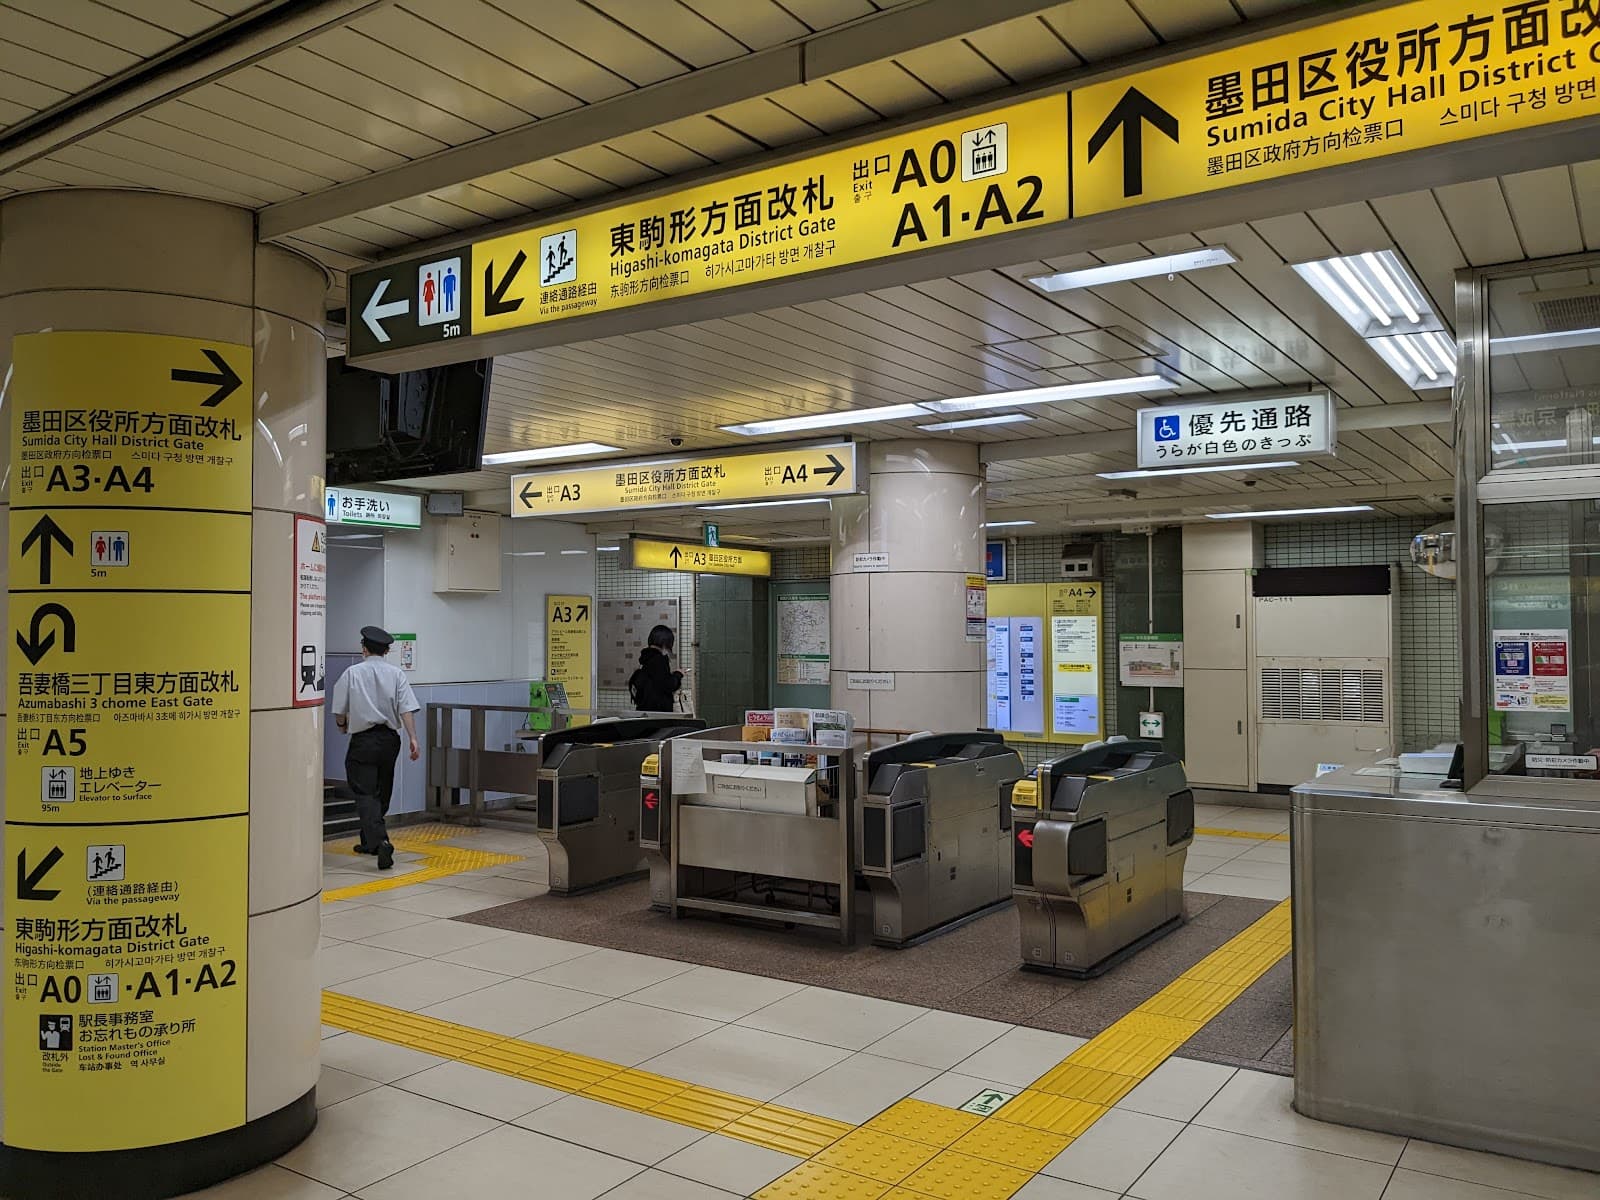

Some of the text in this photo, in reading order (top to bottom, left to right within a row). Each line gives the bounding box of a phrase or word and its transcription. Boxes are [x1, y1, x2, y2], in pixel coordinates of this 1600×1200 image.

[1207, 106, 1308, 147] Sumida
[1319, 95, 1376, 121] City
[1388, 74, 1445, 107] Hall
[1459, 48, 1576, 91] District
[1440, 77, 1597, 126] 스미다 구청 방면
[1207, 118, 1403, 176] 墨田区政府方向检票口
[853, 140, 956, 194] 出口 A0
[854, 180, 872, 192] Exit
[610, 174, 834, 257] 東駒形方面改札
[610, 216, 836, 277] Higashi-komagata District Gate
[705, 240, 836, 280] 히가시고마가타 방면 개찰구
[610, 270, 689, 298] 东驹形方向检票口
[540, 282, 596, 305] 連絡通路経由
[540, 298, 597, 315] Via the passageway
[443, 324, 460, 338] 5m
[22, 410, 242, 441] 墨田区役所方面改札
[1188, 404, 1312, 436] 優先通路
[22, 434, 204, 450] Sumida City Hall District Gate
[1156, 434, 1312, 459] うらが白色のきっぷ
[21, 450, 112, 460] 墨田区政府方向检票口
[131, 451, 234, 466] 스미다 구청 방면 개찰구
[21, 466, 44, 478] 出口
[616, 464, 726, 486] 墨田区役所方面改札
[764, 464, 808, 484] 出口 A4
[546, 484, 580, 502] 出口 A3
[624, 480, 716, 494] Sumida City Hall District Gate
[342, 496, 390, 512] お手洗い
[342, 510, 362, 518] Toilets
[694, 553, 706, 565] A3
[90, 568, 107, 578] 5m
[1068, 588, 1082, 598] A4
[552, 606, 572, 622] A3
[18, 670, 239, 696] 吾妻橋三丁目東方面改札
[18, 696, 213, 708] Azumabashi 3 chome East Gate
[114, 712, 154, 722] 아즈마바시
[156, 711, 177, 721] 3초메
[178, 710, 202, 720] 히가시
[203, 710, 218, 720] 방면
[18, 728, 86, 756] 出口 A5
[80, 766, 136, 780] 地上ゆき
[80, 780, 162, 794] エレベーター
[42, 804, 60, 812] 95m
[86, 894, 180, 906] Via the passageway
[16, 912, 187, 942] 東駒形方面改札
[16, 935, 210, 957] Higashi-komagata District Gate
[105, 947, 225, 968] 히가시고마가타 방면 개찰구
[15, 972, 38, 986] 出口
[40, 976, 82, 1003] A0
[79, 1010, 154, 1028] 駅長事務室
[79, 1018, 196, 1042] お忘れもの承り所
[109, 1042, 144, 1051] Master's
[146, 1038, 171, 1047] Office
[42, 1052, 70, 1062] 改札外
[78, 1053, 96, 1061] Lost
[105, 1051, 132, 1060] Found
[134, 1049, 158, 1058] Office
[130, 1056, 166, 1068] 역 사무실
[79, 1062, 122, 1072] 车站办事处
